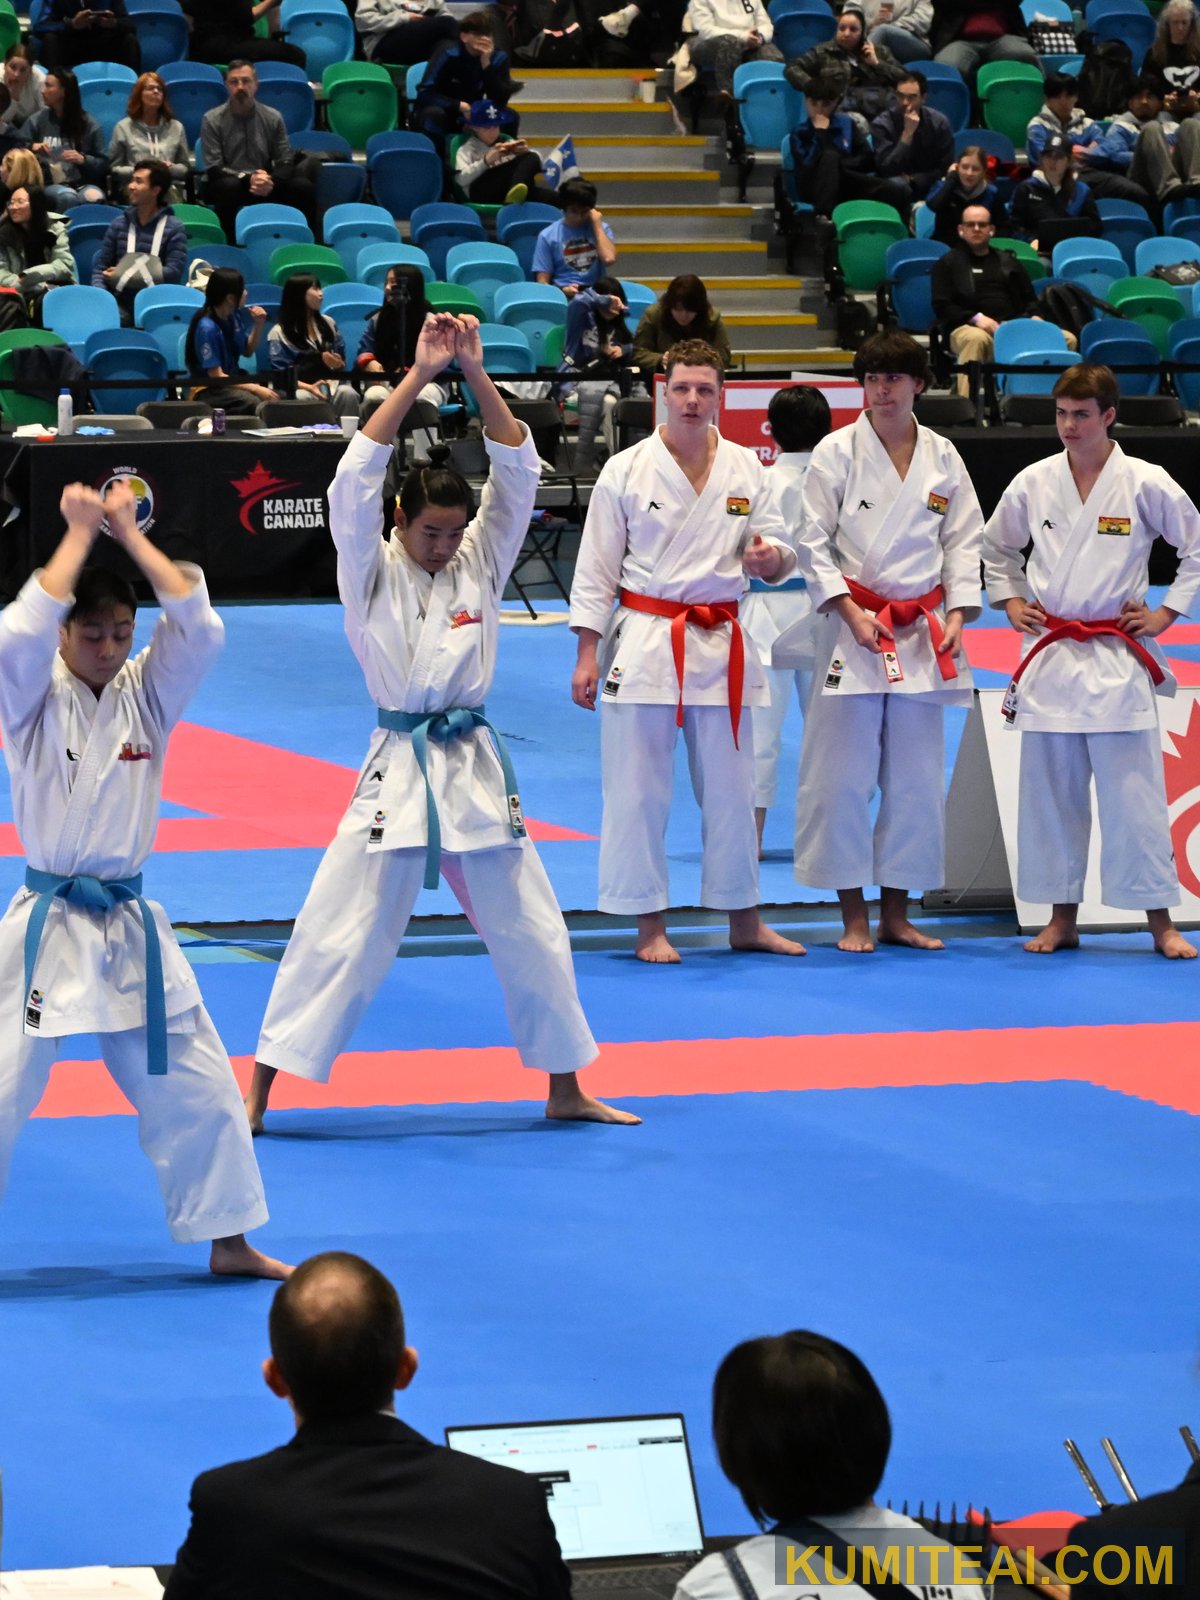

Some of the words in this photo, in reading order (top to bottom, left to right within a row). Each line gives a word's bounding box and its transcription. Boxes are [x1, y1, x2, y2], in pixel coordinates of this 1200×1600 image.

[112, 466, 138, 475] WORLD
[263, 498, 323, 514] KARATE
[263, 513, 325, 530] CANADA
